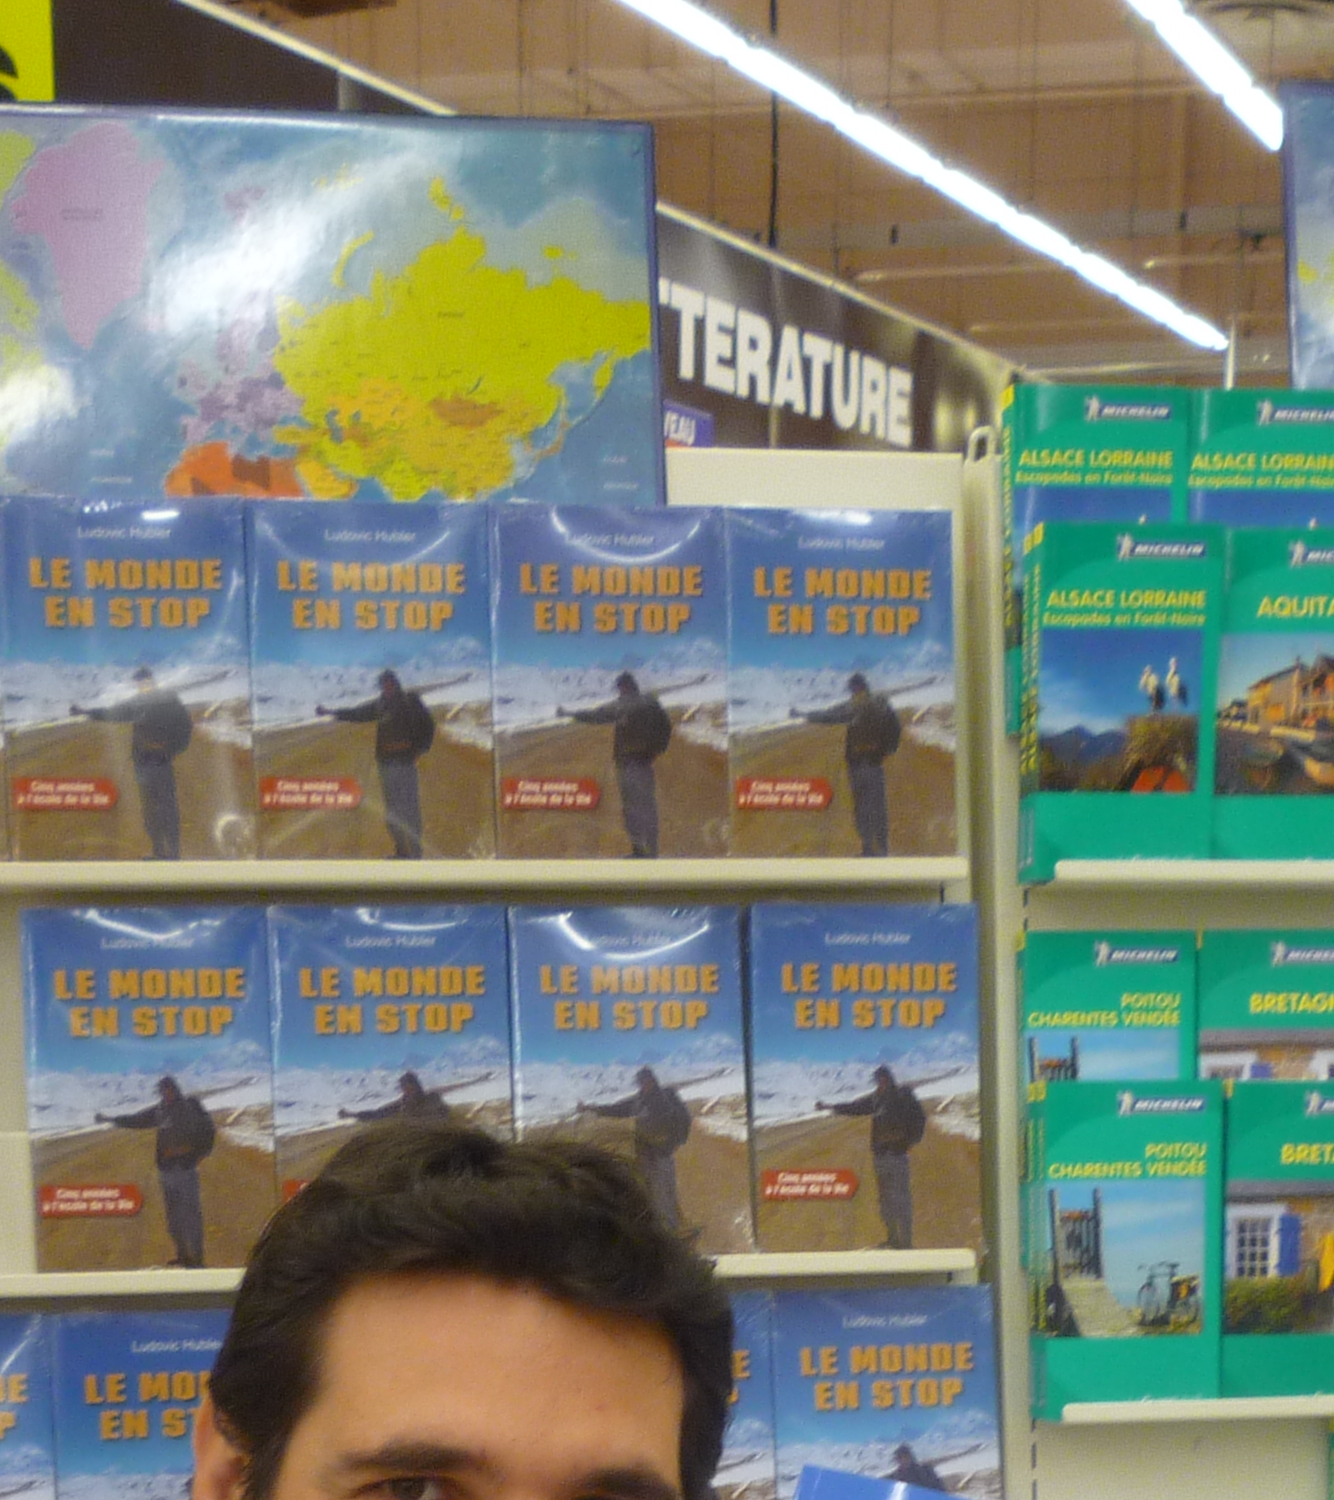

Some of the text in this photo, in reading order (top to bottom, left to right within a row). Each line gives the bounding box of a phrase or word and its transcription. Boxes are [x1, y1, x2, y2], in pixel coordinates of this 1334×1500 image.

[278, 561, 463, 592] LE MONDE
[755, 568, 928, 598] LE MONDE
[1047, 590, 1205, 608] ALSACE LORRAINE
[294, 599, 452, 630] EN STOP
[769, 604, 919, 634] EN STOP
[1112, 947, 1179, 962] MICHELIN
[783, 964, 954, 992] LE MONDE
[796, 999, 944, 1027] EN STOP
[1135, 1098, 1204, 1113] MICHELIN
[1146, 1143, 1207, 1159] POITOU
[1048, 1162, 1142, 1179] CHARENTES
[801, 1344, 971, 1375] LE MONDE
[816, 1378, 962, 1409] EN STOP
